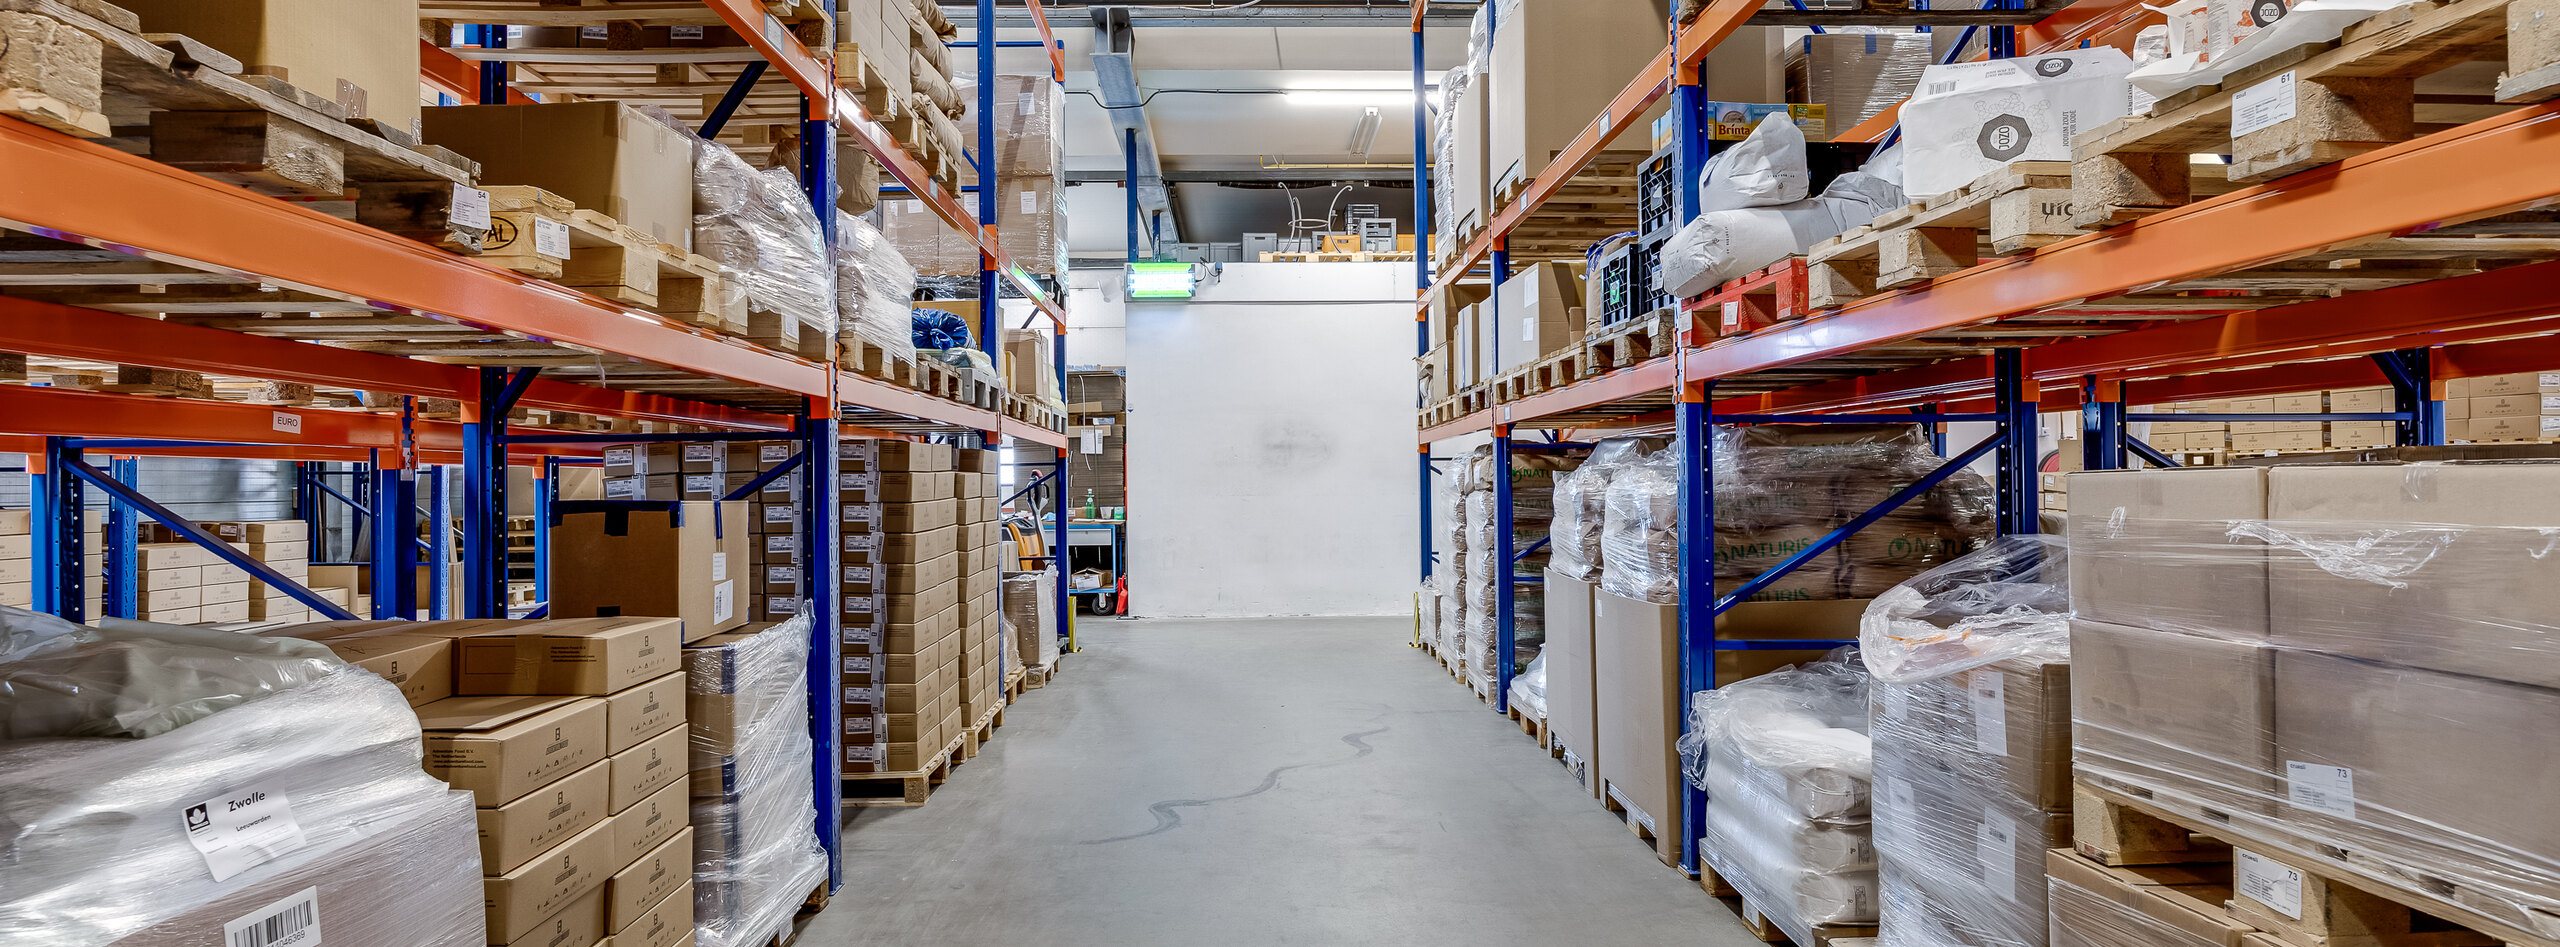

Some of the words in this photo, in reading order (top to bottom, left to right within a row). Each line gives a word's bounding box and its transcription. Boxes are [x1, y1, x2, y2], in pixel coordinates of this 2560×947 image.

[2260, 8, 2279, 17] JOZO
[2044, 62, 2062, 70] JOZO
[2280, 73, 2290, 84] 61
[1718, 122, 1750, 135] Brinta
[1998, 126, 2010, 149] JOZO
[478, 191, 486, 199] 54
[278, 416, 298, 427] EURO
[1731, 537, 1810, 561] NATURIS
[2336, 768, 2348, 778] 73
[228, 792, 266, 812] Zwolle
[236, 814, 272, 832] Leeuwarden
[2288, 870, 2298, 881] 73
[266, 929, 305, 947] 046369
